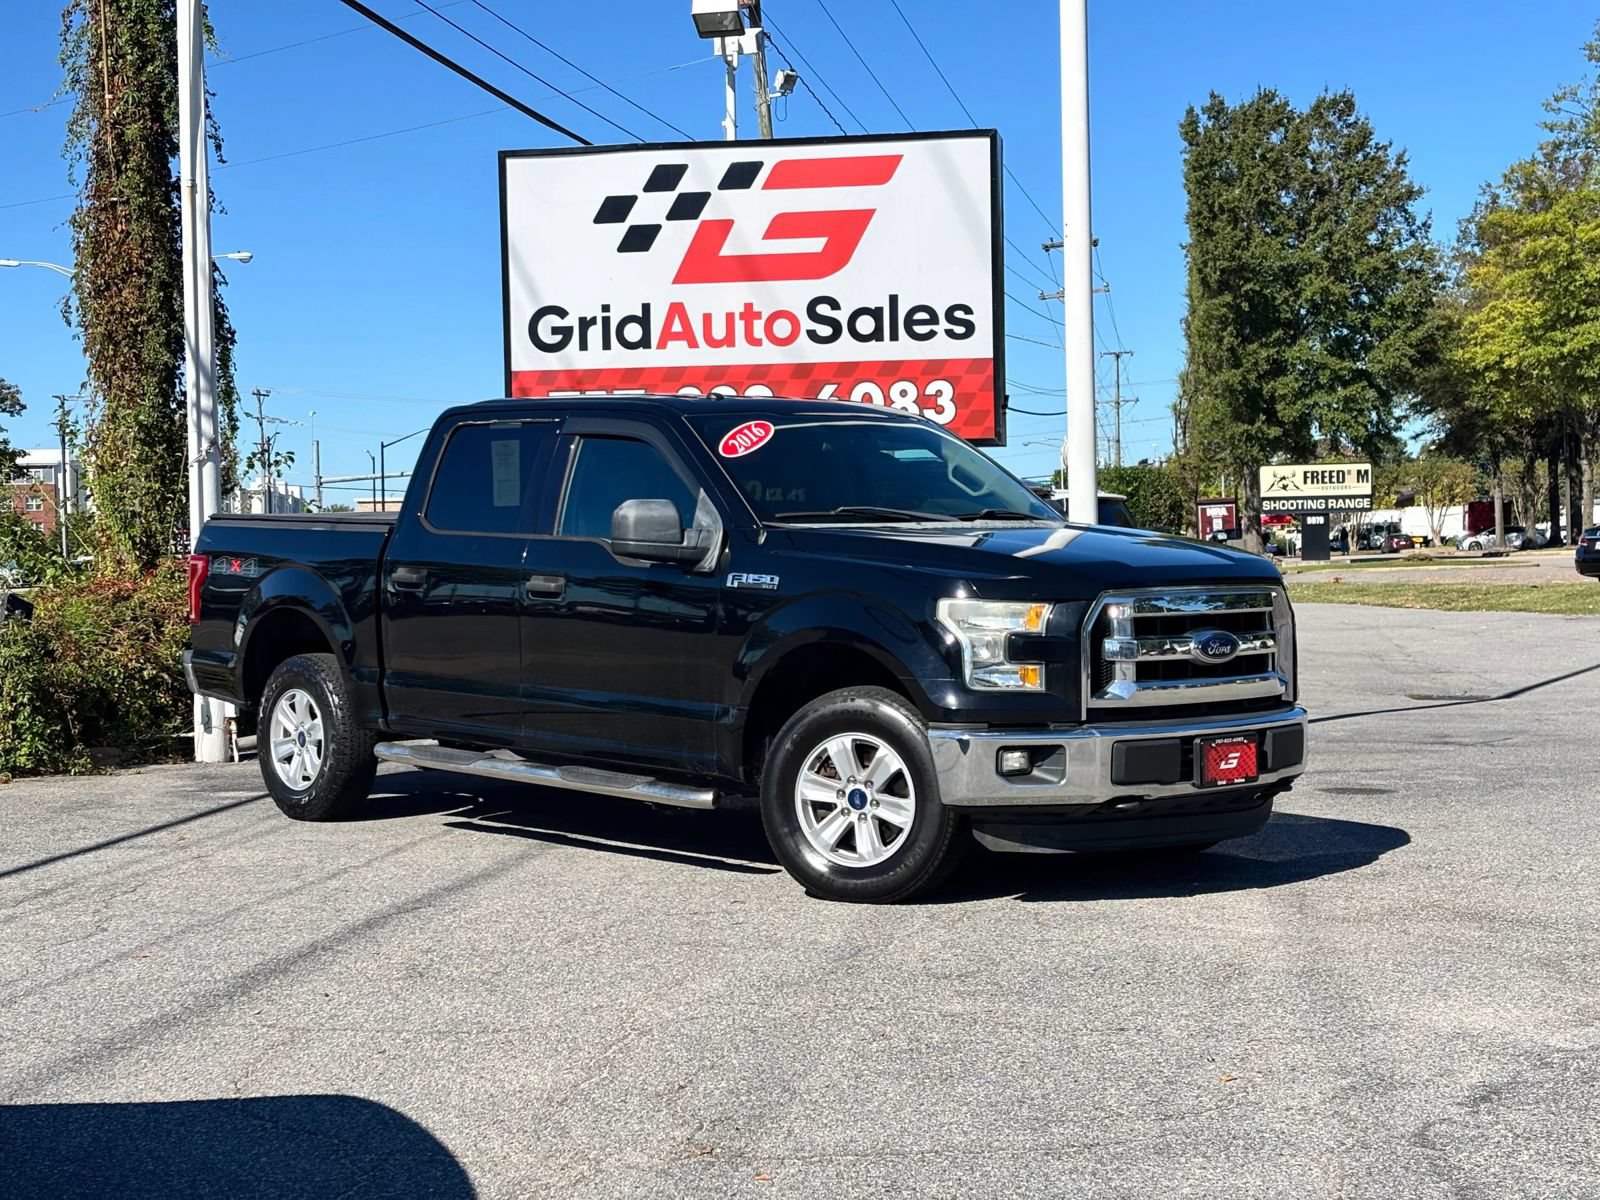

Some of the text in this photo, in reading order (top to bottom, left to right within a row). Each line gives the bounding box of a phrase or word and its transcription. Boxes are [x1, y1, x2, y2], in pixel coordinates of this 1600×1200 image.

[528, 294, 976, 354] GridAutoSales
[728, 422, 767, 454] 2016
[1262, 498, 1371, 511] SHOOTING RANGE
[1208, 640, 1231, 655] Ford
